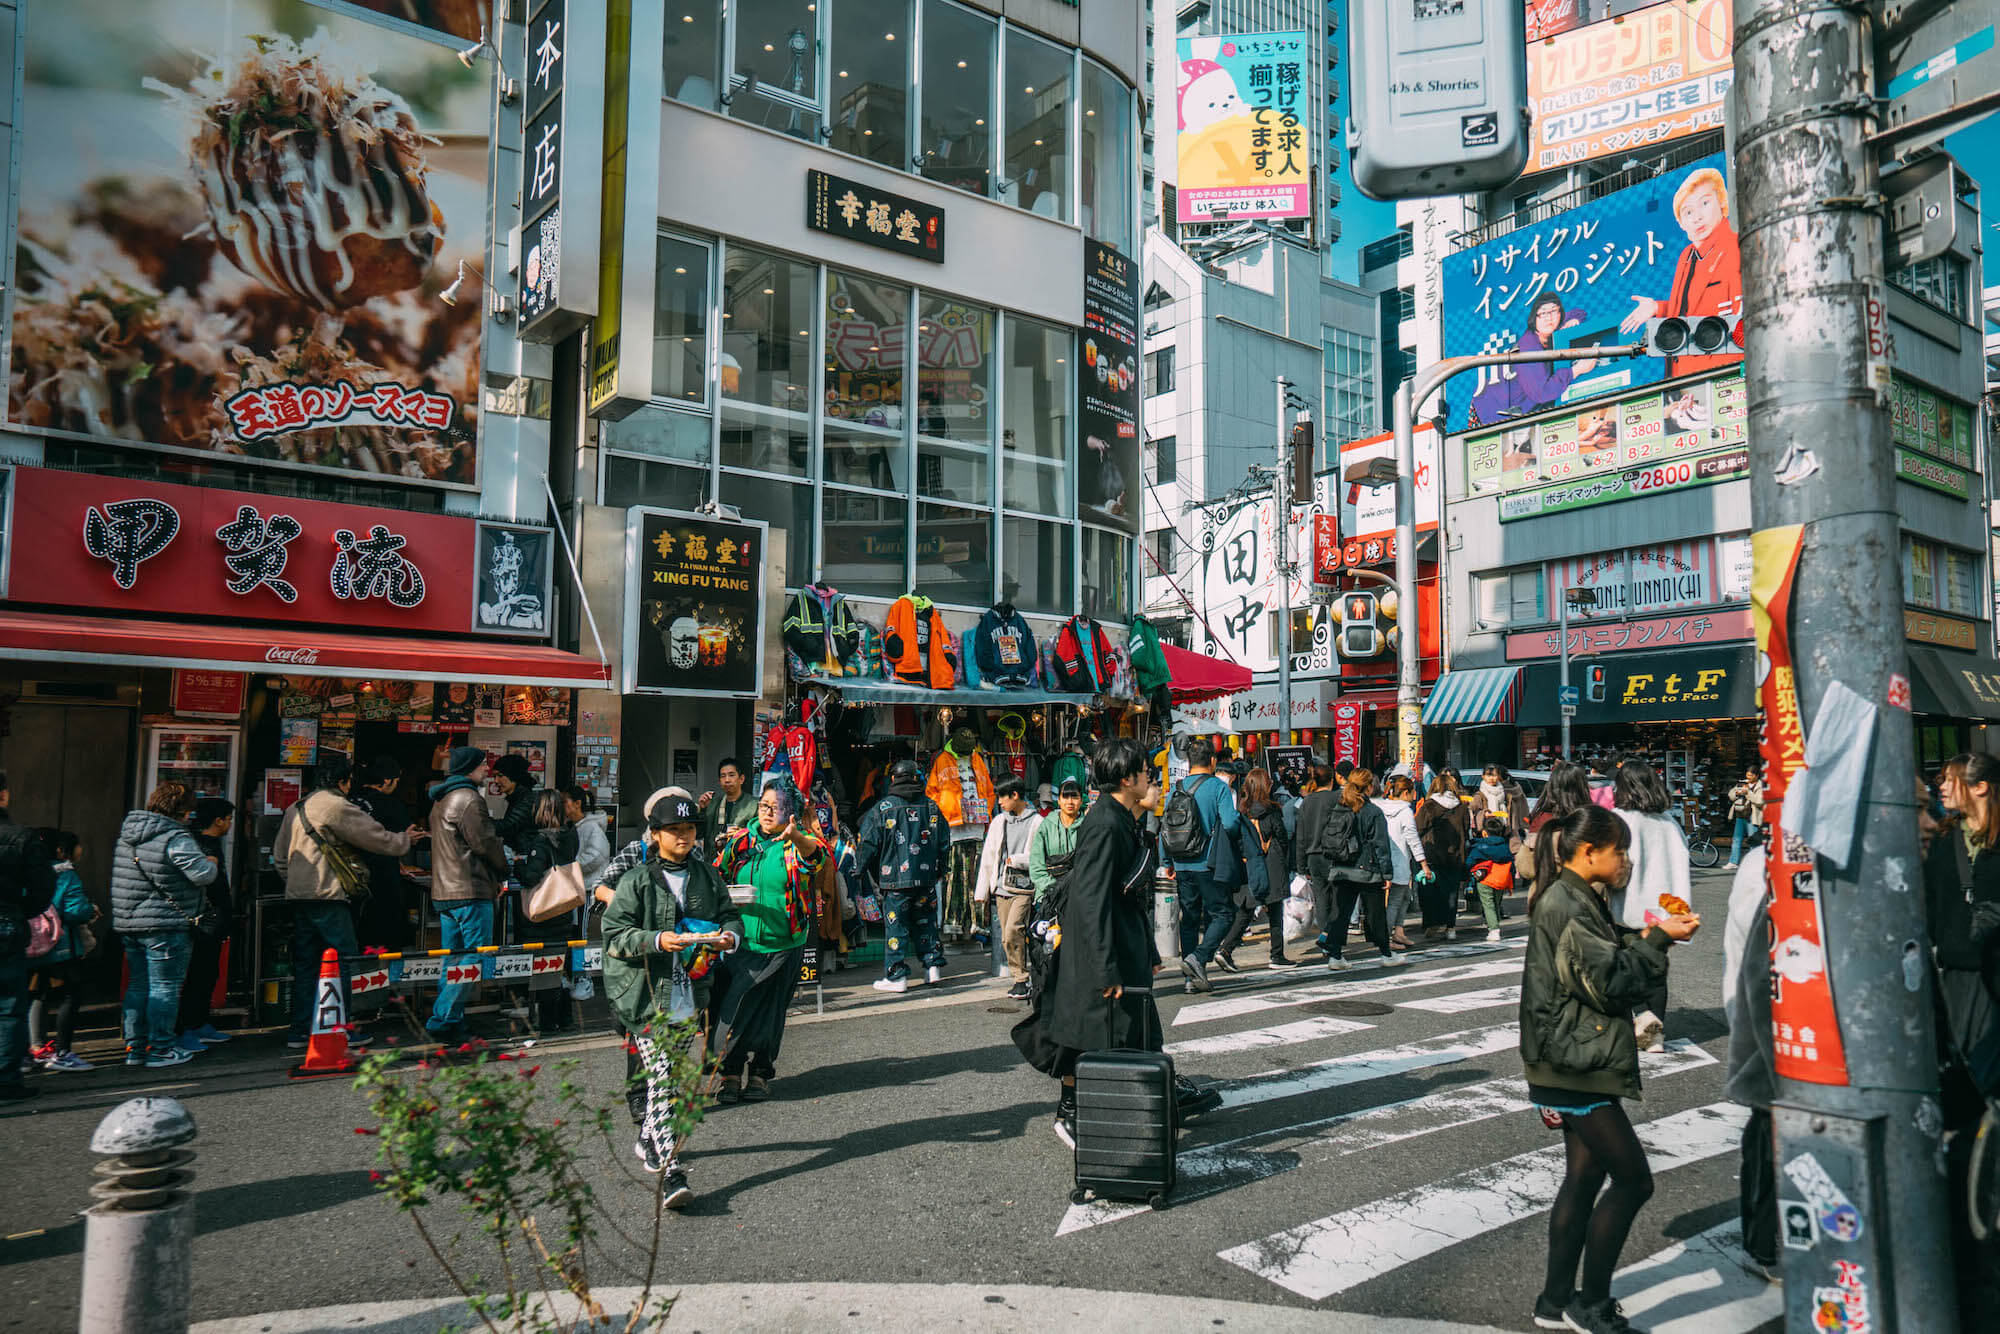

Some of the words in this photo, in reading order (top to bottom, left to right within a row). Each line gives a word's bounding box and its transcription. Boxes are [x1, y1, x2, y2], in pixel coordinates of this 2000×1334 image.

[1238, 39, 1302, 53] いちごなび
[1413, 82, 1423, 92] &
[1428, 78, 1480, 91] Shorties
[530, 20, 562, 201] 本店
[1249, 64, 1274, 178] 揃ってます。
[1276, 62, 1301, 176] 稼げる求人
[1547, 84, 1701, 140] オリエント住宅
[835, 190, 921, 244] 幸福堂
[1255, 199, 1278, 210] 体入
[1472, 219, 1600, 287] リサイクル
[1474, 230, 1664, 320] インクのジット
[227, 382, 456, 438] 王道のソースマヨ
[1544, 478, 1624, 506] ボディマッサージ
[1632, 464, 1690, 490] ¥2800
[84, 498, 426, 608] 甲賀流
[652, 530, 738, 565] 幸福堂
[653, 570, 689, 585] XING
[692, 574, 710, 587] FU
[712, 576, 750, 591] TANG
[679, 562, 708, 571] TAIWAN
[709, 564, 727, 574] NO.1
[1576, 569, 1594, 585] USED
[1594, 553, 1637, 573] CLOTHIG
[1638, 553, 1645, 561] &
[1670, 558, 1692, 572] SHOP
[1223, 529, 1264, 657] 田中
[1545, 617, 1713, 654] サントニブンノイチ
[265, 646, 321, 665] Coca-Cola
[1229, 700, 1257, 720] 田中
[1622, 696, 1657, 705] Face
[1661, 695, 1677, 703] to
[1681, 692, 1719, 702] Face
[801, 966, 817, 981] 3F
[320, 982, 341, 1031] 入口
